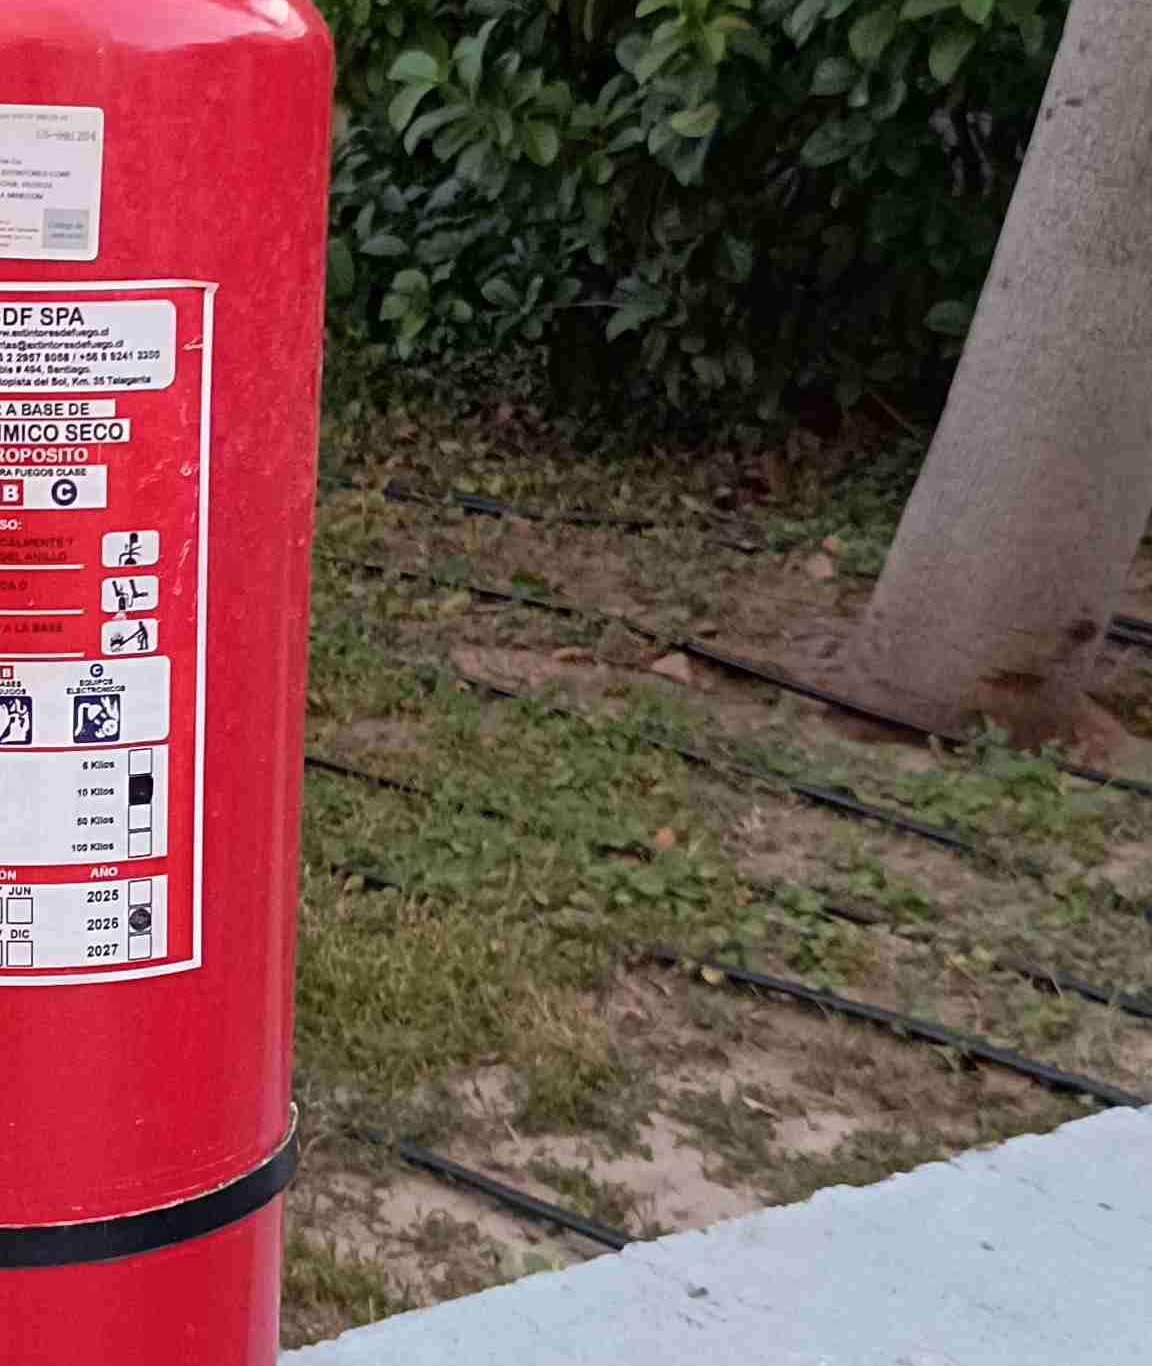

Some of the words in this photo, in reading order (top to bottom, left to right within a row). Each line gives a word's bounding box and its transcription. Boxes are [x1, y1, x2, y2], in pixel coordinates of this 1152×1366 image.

[40, 306, 84, 326] SPA
[6, 352, 14, 363] 2
[33, 377, 49, 387] del
[5, 402, 18, 416] A
[21, 402, 64, 417] BASE
[68, 402, 90, 416] DE
[65, 423, 124, 441] SECO
[15, 467, 54, 477] FUEGOS
[56, 467, 87, 477] CLASE
[1, 485, 19, 502] B
[91, 760, 115, 770] Kilos
[90, 787, 115, 796] Kilos
[90, 816, 114, 826] Kilos
[90, 842, 114, 852] Kilos
[8, 886, 31, 896] JUN
[86, 889, 119, 903] 2025
[86, 917, 119, 931] 2026
[10, 929, 30, 939] DIC
[86, 943, 119, 957] 2027
